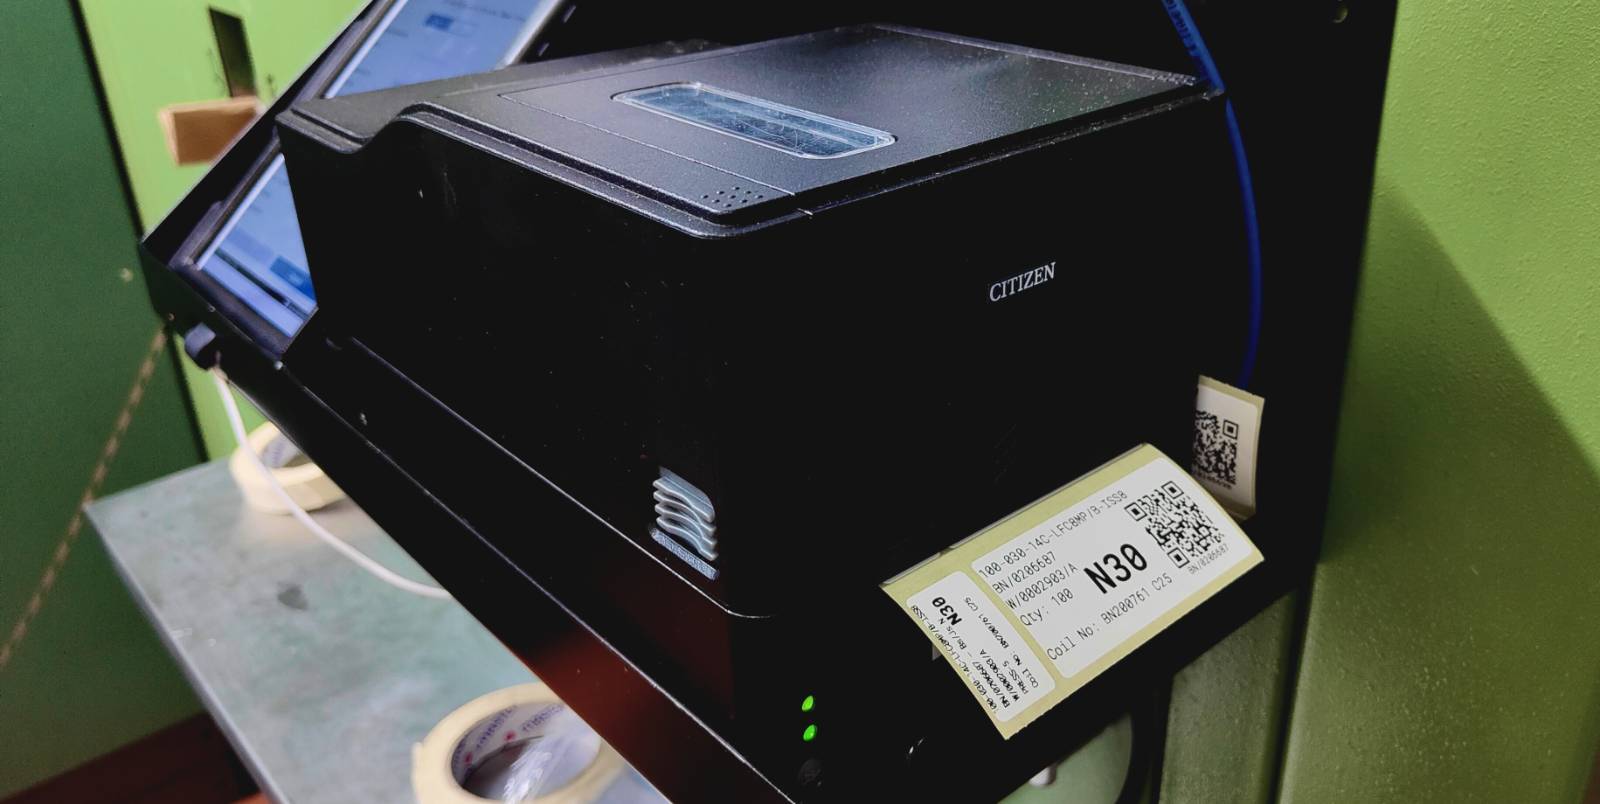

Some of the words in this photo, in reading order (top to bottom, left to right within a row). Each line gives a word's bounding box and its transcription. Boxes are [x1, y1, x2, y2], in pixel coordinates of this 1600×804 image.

[989, 261, 1056, 302] CITIZEN
[992, 551, 1057, 594] BN/0206687
[1006, 562, 1079, 610] W/0002903/A
[1083, 543, 1148, 594] N30
[932, 596, 962, 626] N30
[1020, 605, 1049, 627] Qty:
[1051, 588, 1074, 606] 100
[1046, 636, 1076, 661] Coil
[1077, 623, 1099, 641] No:
[1100, 587, 1150, 625] BN200761
[1151, 572, 1173, 591] C25
